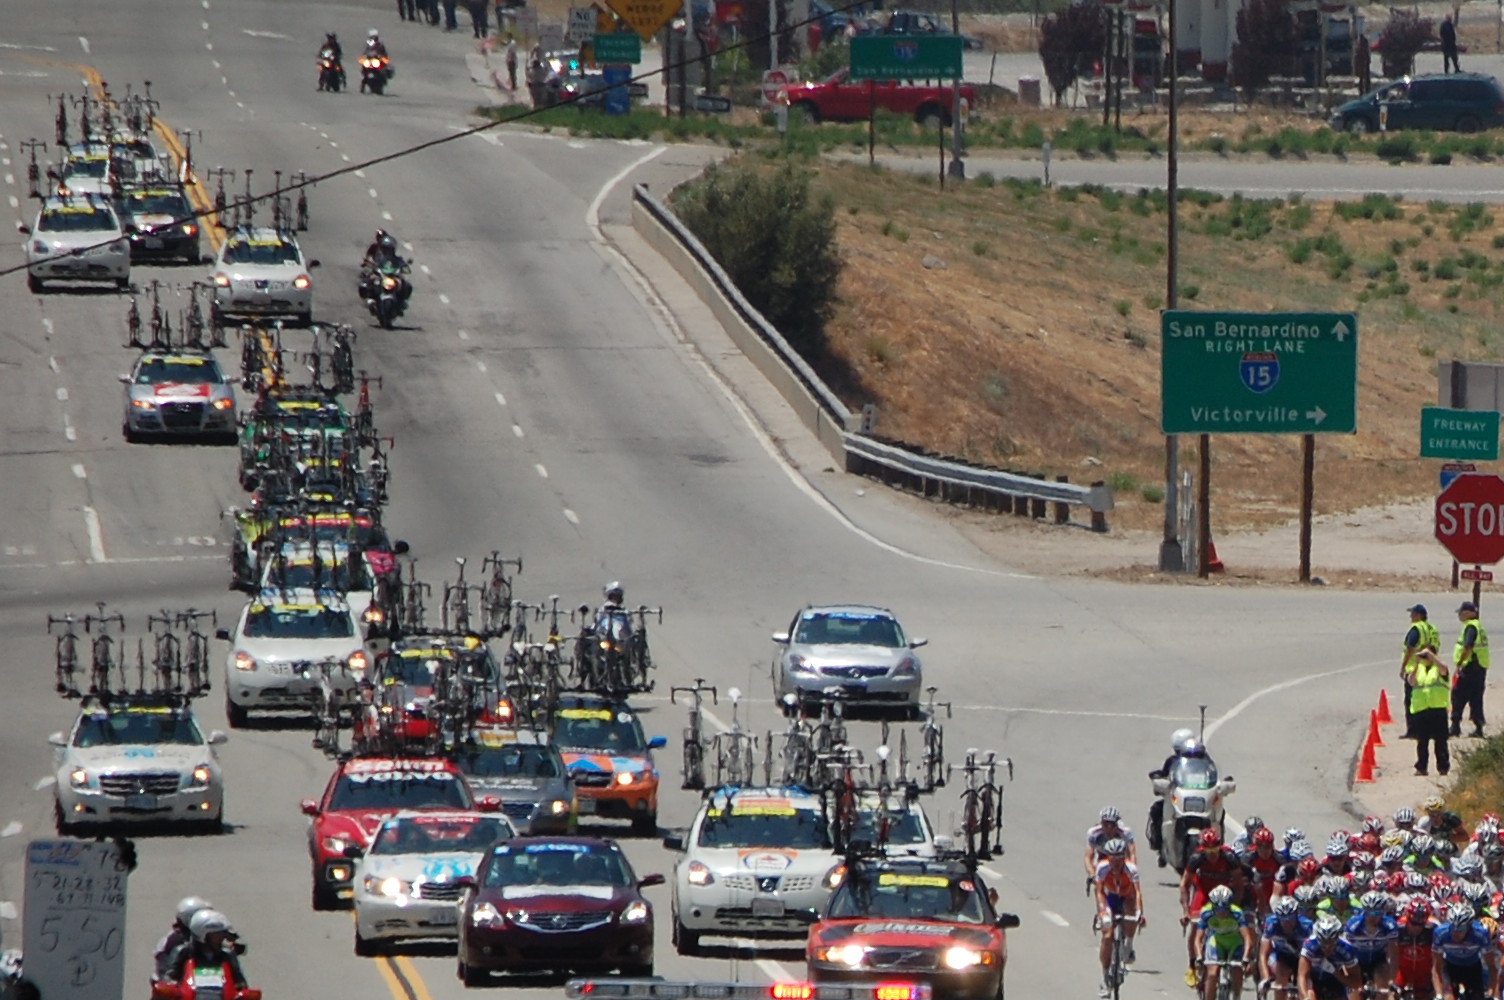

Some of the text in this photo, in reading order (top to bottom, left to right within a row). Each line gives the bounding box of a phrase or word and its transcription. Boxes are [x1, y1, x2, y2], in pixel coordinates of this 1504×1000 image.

[1169, 321, 1320, 338] San Bernardino
[1205, 340, 1306, 353] RIGHT LANE
[1247, 365, 1271, 386] 15
[1190, 406, 1298, 422] Victorville
[1433, 418, 1487, 432] FREEWAY
[1429, 438, 1489, 451] ENTRANCE
